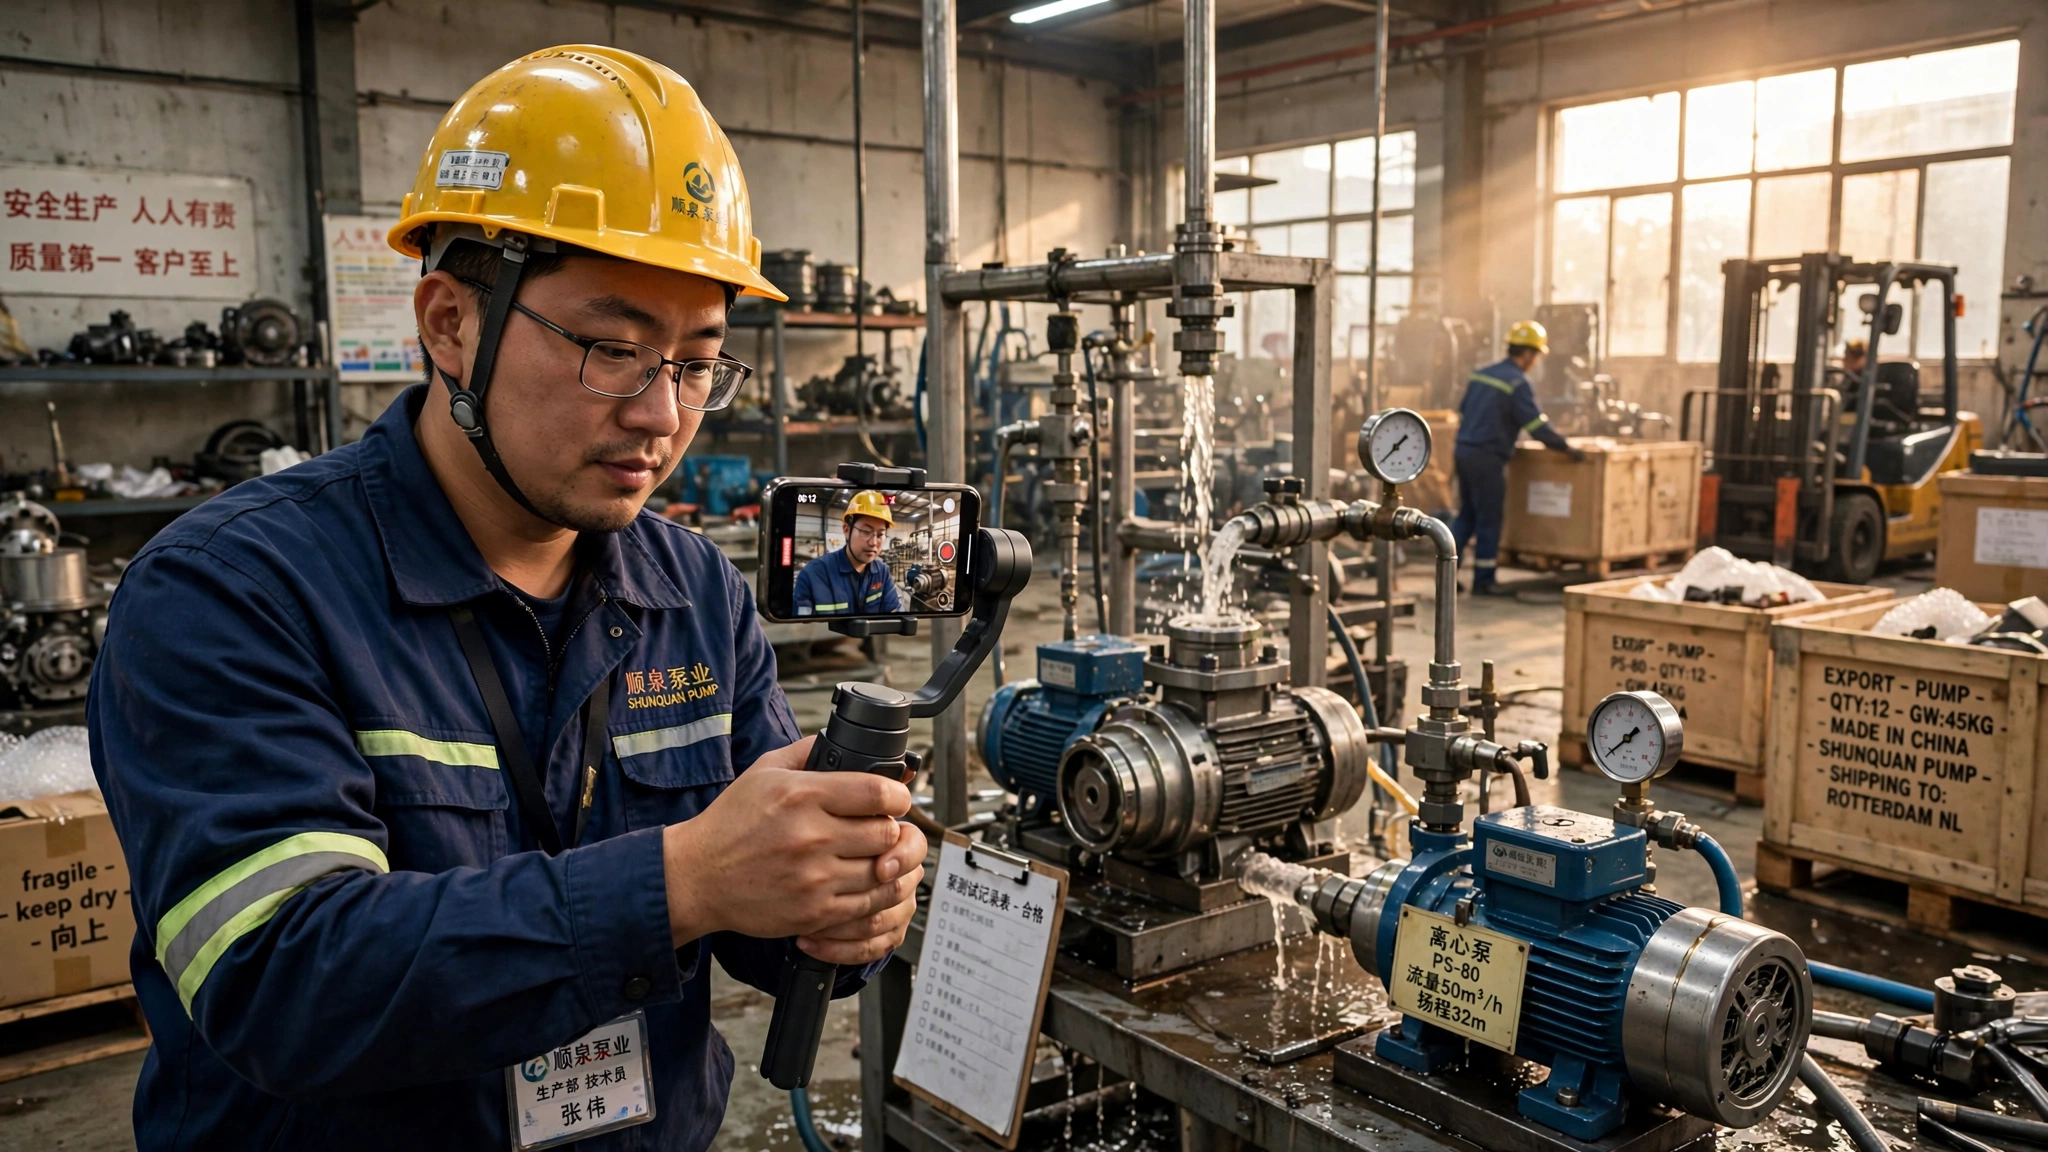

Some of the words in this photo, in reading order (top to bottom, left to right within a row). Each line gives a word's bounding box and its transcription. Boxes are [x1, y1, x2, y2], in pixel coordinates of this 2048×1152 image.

[4, 188, 117, 222] 安全生产
[132, 196, 236, 229] 人人有责
[9, 242, 122, 273] 质量第一
[134, 247, 239, 278] 客户至上
[1667, 642, 1705, 660] PUMP
[625, 662, 713, 695] 顺泉泵业
[1659, 662, 1706, 683] QTY:12
[1824, 666, 1895, 693] EXPORT
[1915, 679, 1970, 704] PUMP
[628, 692, 686, 710] SHUNQUAN
[688, 683, 719, 702] PUMP
[1830, 692, 1890, 718] QTY:12
[1910, 704, 1994, 735] GW:45KG
[1830, 717, 1880, 741] MADE
[1886, 726, 1904, 745] IN
[1911, 730, 1969, 757] CHINA
[1819, 739, 1917, 773] SHUNQUAN
[1923, 757, 1977, 784] PUMP
[1830, 764, 1910, 797] SHIPPING
[1917, 781, 1947, 804] TO:
[1827, 788, 1932, 826] ROTTERDAM
[1939, 811, 1963, 833] NL
[22, 861, 97, 891] fragile
[16, 898, 72, 922] keep
[80, 887, 117, 910] dry
[1022, 901, 1043, 924] 合格
[51, 918, 109, 952] 向上
[1429, 925, 1492, 964] 离心泵
[1433, 952, 1480, 982] PS-80
[1417, 990, 1486, 1032] 扬程32m
[553, 1035, 631, 1071] 顺泉泵业
[536, 1077, 579, 1102] 生产部
[585, 1066, 627, 1090] 技术员
[561, 1095, 606, 1127] 张伟
